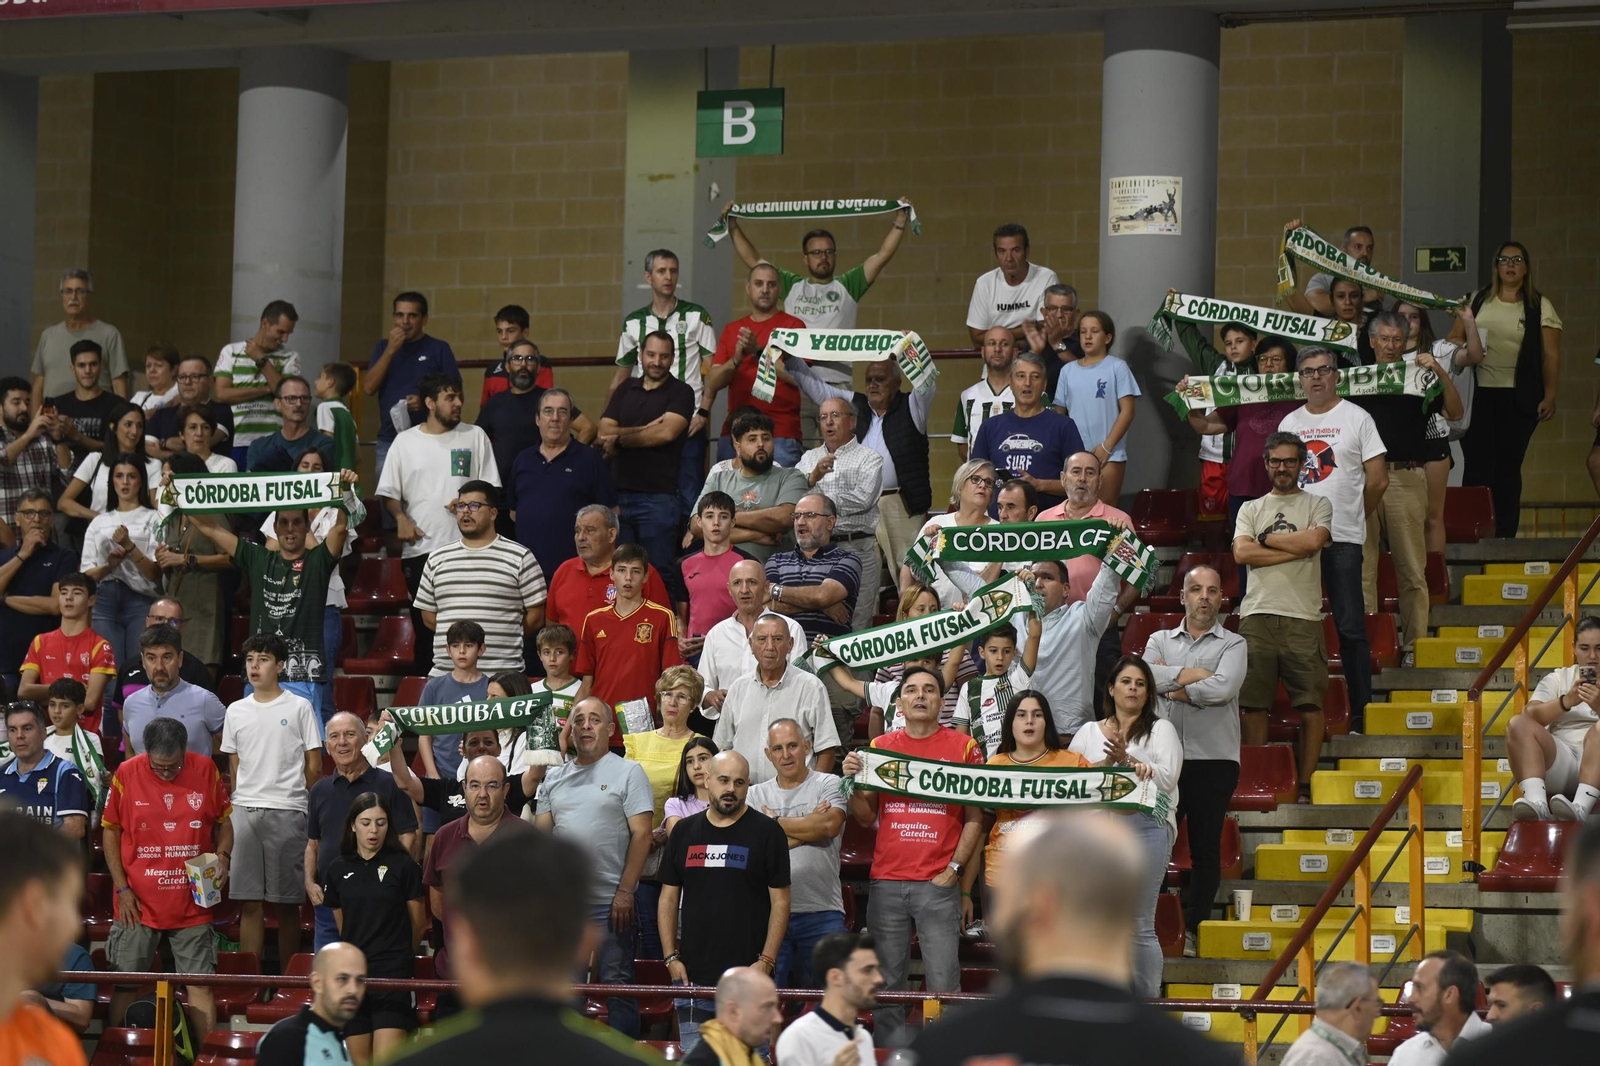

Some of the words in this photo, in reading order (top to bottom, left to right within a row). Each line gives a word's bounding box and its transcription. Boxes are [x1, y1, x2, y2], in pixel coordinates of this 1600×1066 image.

[723, 100, 756, 145] B
[1291, 231, 1347, 267] RDOBA
[793, 305, 841, 316] INFINITA
[1187, 298, 1258, 329] CÓRDOBA
[1263, 311, 1317, 337] FUTSAL
[1214, 364, 1404, 396] CORBA
[1258, 391, 1308, 402] Cordobesist
[1006, 454, 1032, 471] SURF
[185, 480, 260, 505] CÓRDOBA
[266, 479, 323, 502] FUTSAL
[953, 527, 1073, 552] CÓRDOBA
[1079, 528, 1111, 548] CF
[840, 626, 918, 664] CÓRDOBA
[920, 608, 982, 645] FUTSAL
[509, 698, 541, 718] CF
[919, 767, 1013, 796] CÓRDOBA
[1019, 776, 1092, 800] FUTSAL
[900, 829, 938, 839] Catedral
[688, 852, 745, 863] JACK&JONES
